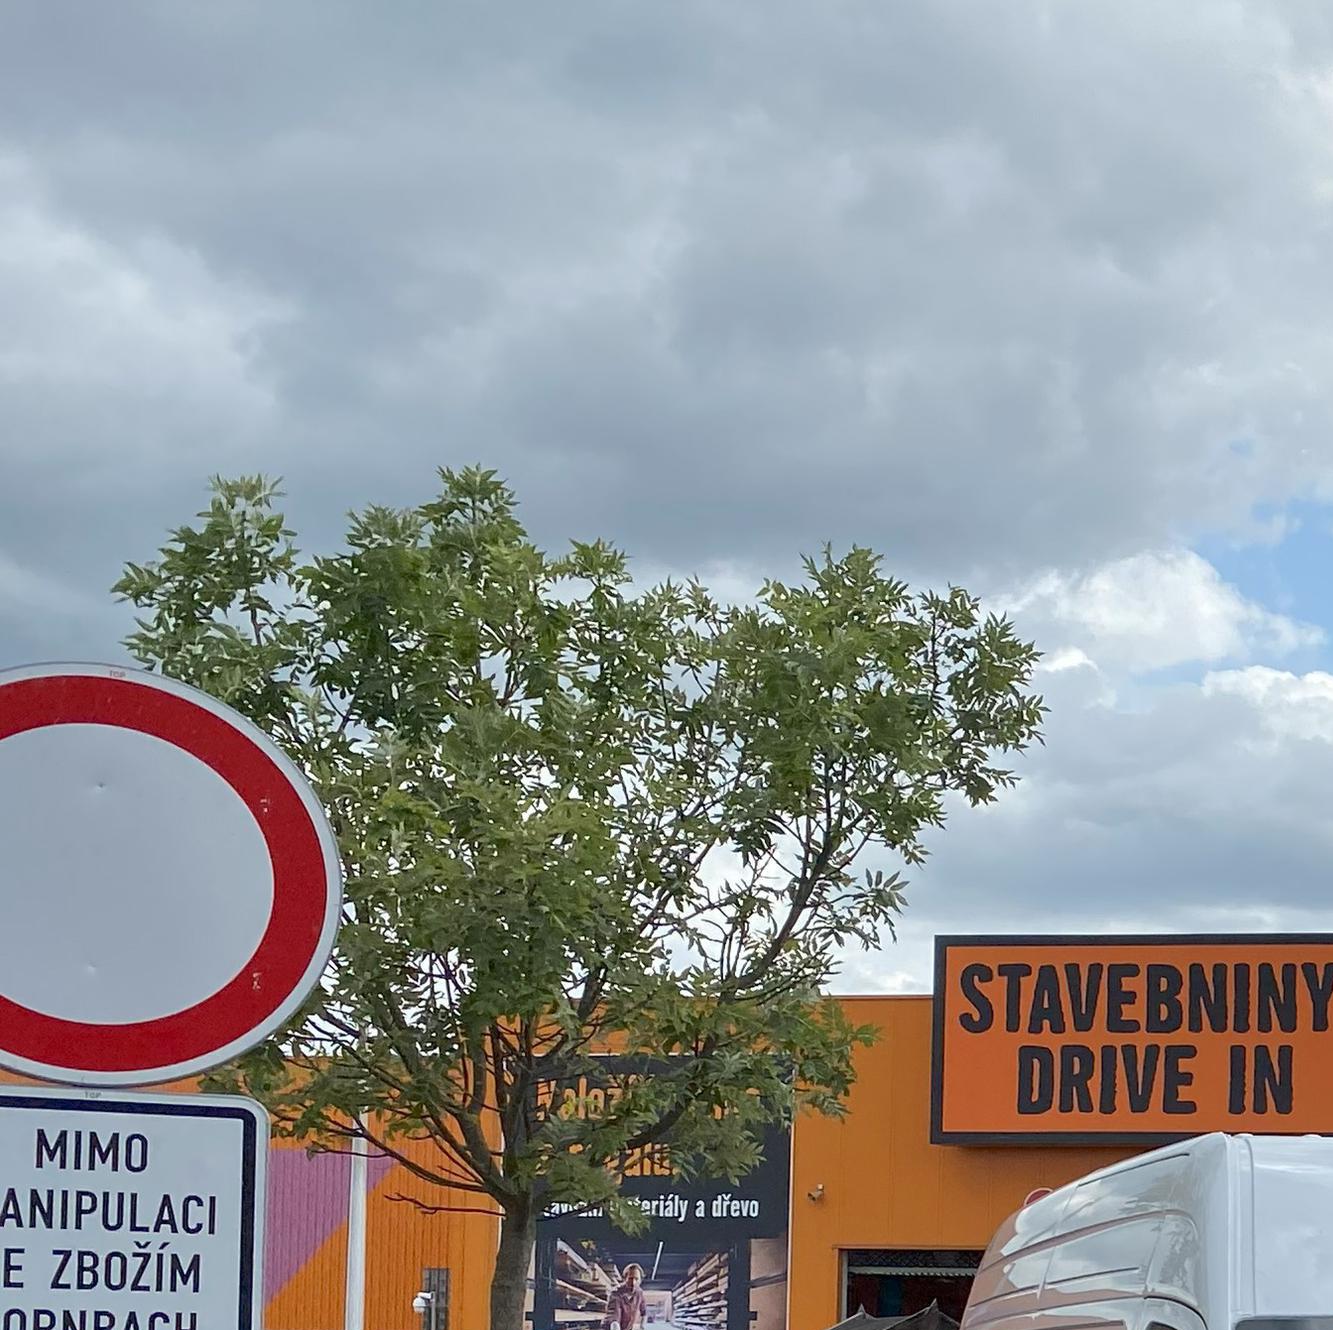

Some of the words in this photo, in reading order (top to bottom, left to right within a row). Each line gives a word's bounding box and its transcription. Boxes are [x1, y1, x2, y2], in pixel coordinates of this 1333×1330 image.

[1017, 1044, 1198, 1115] DRIVE
[1228, 1044, 1294, 1115] IN
[35, 1128, 149, 1173] MIMO
[0, 1187, 217, 1236] ANIPULACI
[695, 1202, 705, 1217] a
[712, 1194, 759, 1217] dřevo
[3, 1247, 26, 1289] E
[50, 1240, 201, 1293] ZBOŽÍM
